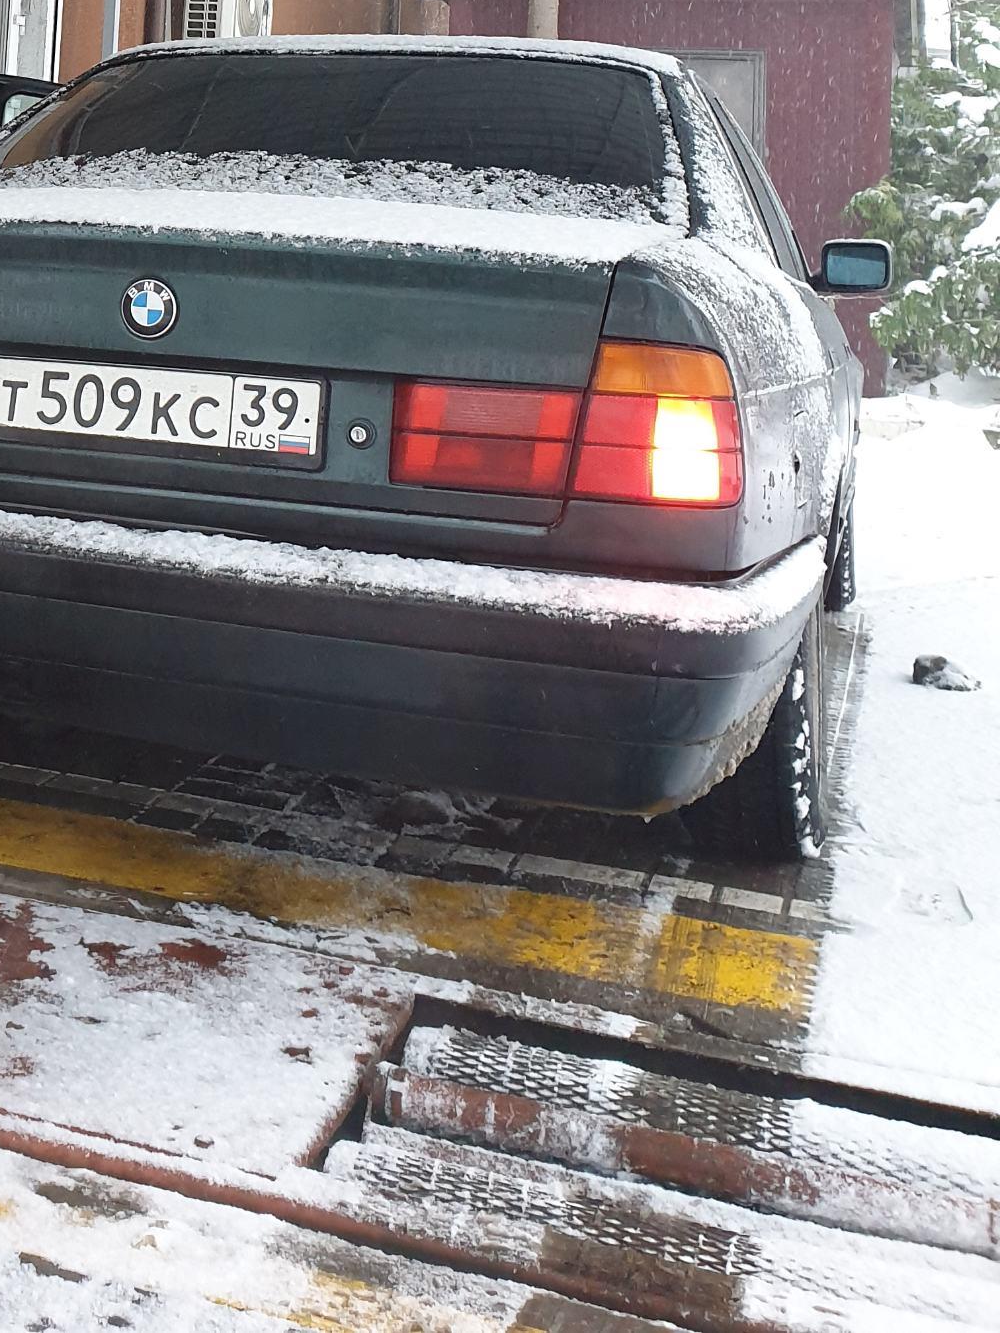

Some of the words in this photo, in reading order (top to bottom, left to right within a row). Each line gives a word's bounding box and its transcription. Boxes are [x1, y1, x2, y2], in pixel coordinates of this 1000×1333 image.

[127, 281, 171, 301] BMW
[240, 384, 299, 430] 39
[234, 431, 276, 449] RUS
